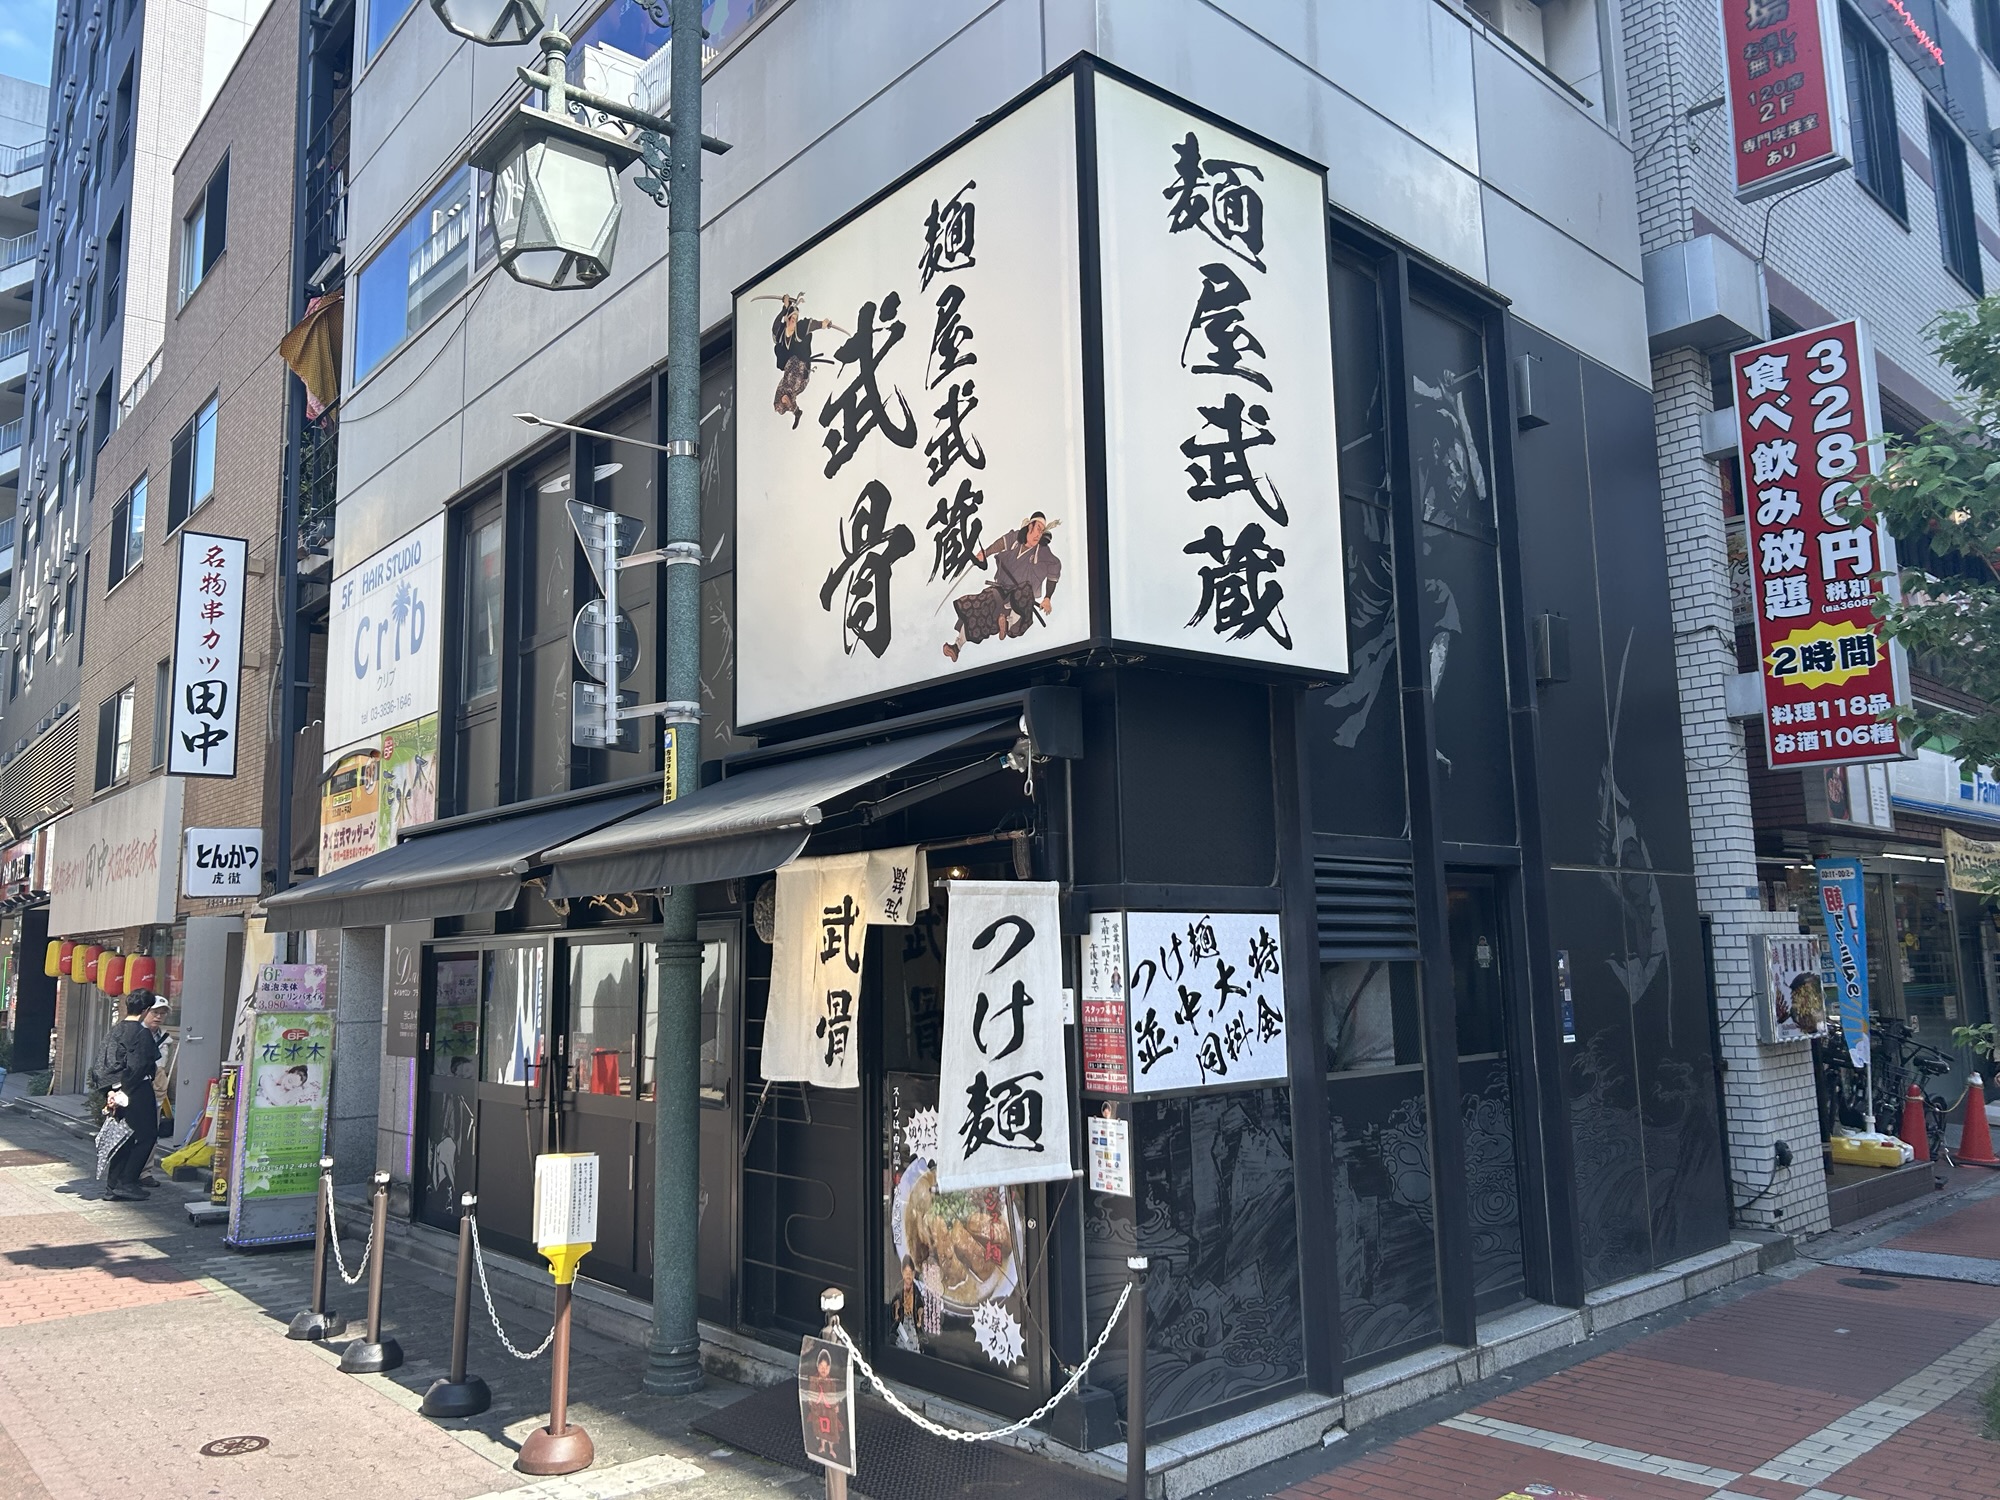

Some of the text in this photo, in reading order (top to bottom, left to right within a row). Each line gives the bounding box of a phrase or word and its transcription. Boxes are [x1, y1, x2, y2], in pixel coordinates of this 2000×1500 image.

[1748, 43, 1796, 80] 無料
[1748, 72, 1804, 107] 120席
[1759, 93, 1795, 124] 2F
[1766, 142, 1797, 167] あり
[917, 179, 989, 585] 麺屋武蔵
[1162, 131, 1291, 651] 麺屋武蔵
[819, 291, 918, 659] 武骨
[1804, 337, 1874, 580] 3280円
[1742, 352, 1812, 621] 食べ飲み放題
[362, 540, 422, 596] HAIR STUDIO
[341, 579, 354, 611] 5F
[1825, 577, 1871, 601] 税別
[1771, 632, 1877, 678] 2時間
[1771, 693, 1892, 726] 料理118品
[1774, 723, 1896, 754] お酒106種
[196, 844, 259, 869] とんかつ
[212, 872, 241, 885] 虎徹
[1101, 916, 1110, 975] 午前十一時より
[1112, 922, 1121, 963] 営業時間
[1131, 915, 1220, 1001] つけ麺
[263, 966, 282, 981] 6F
[816, 893, 861, 1068] 武骨
[1089, 943, 1099, 993] 午後十時まで
[262, 1042, 326, 1065] 花水木
[287, 1032, 305, 1041] 6F
[958, 914, 1046, 1161] つけ麺
[215, 1181, 226, 1191] 3F
